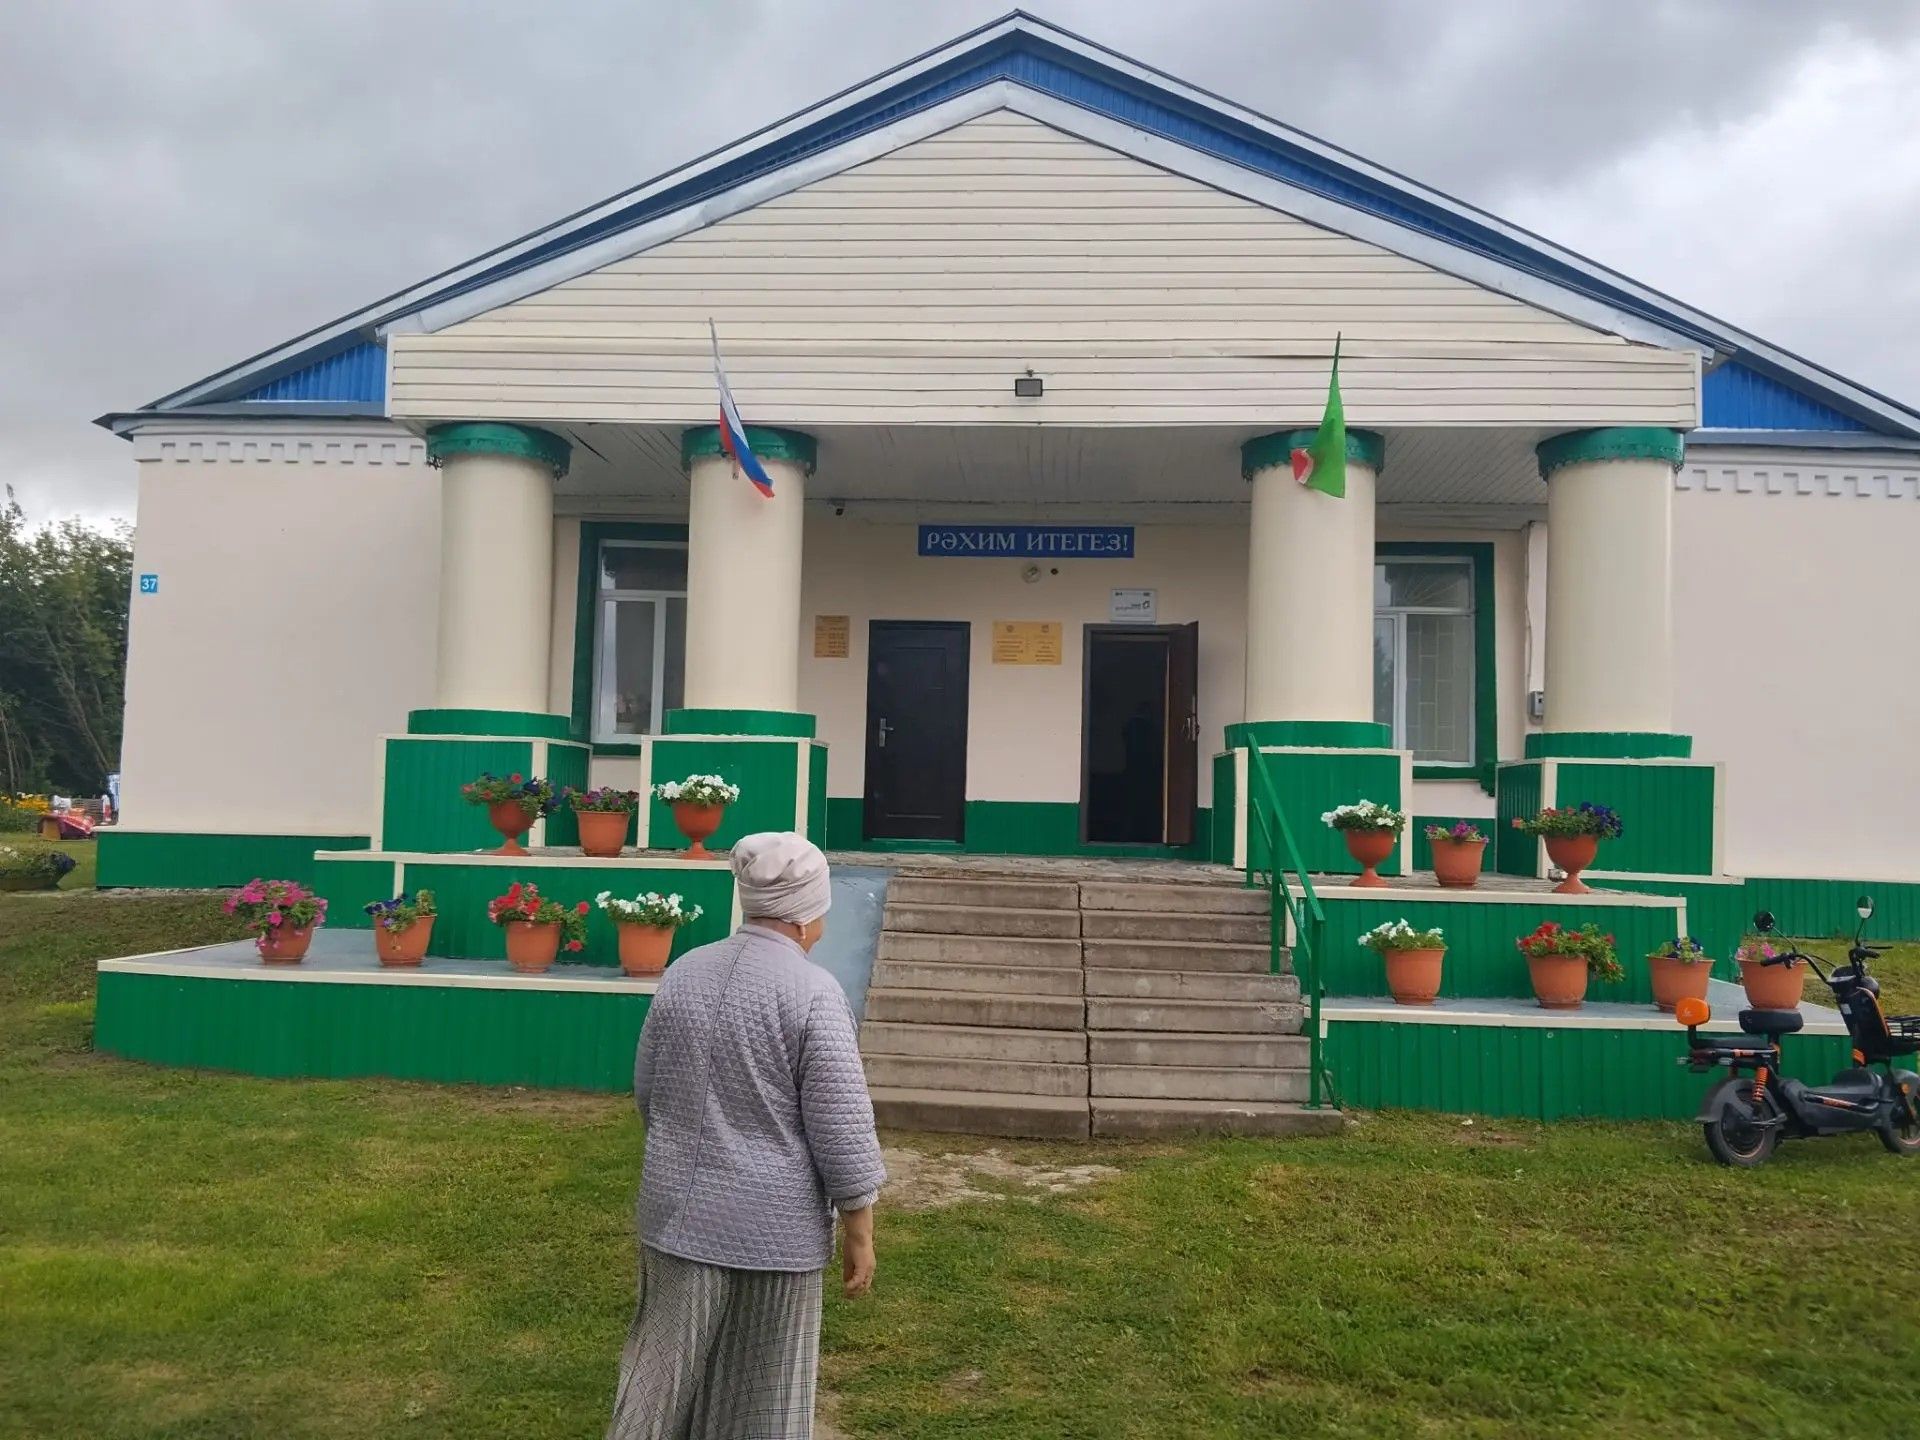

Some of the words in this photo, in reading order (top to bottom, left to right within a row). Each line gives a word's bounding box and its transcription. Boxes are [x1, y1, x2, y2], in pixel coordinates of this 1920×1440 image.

[926, 531, 1015, 550] РӘХИМ
[1026, 532, 1129, 551] ИТЕГЕЗ!
[141, 578, 157, 590] 37
